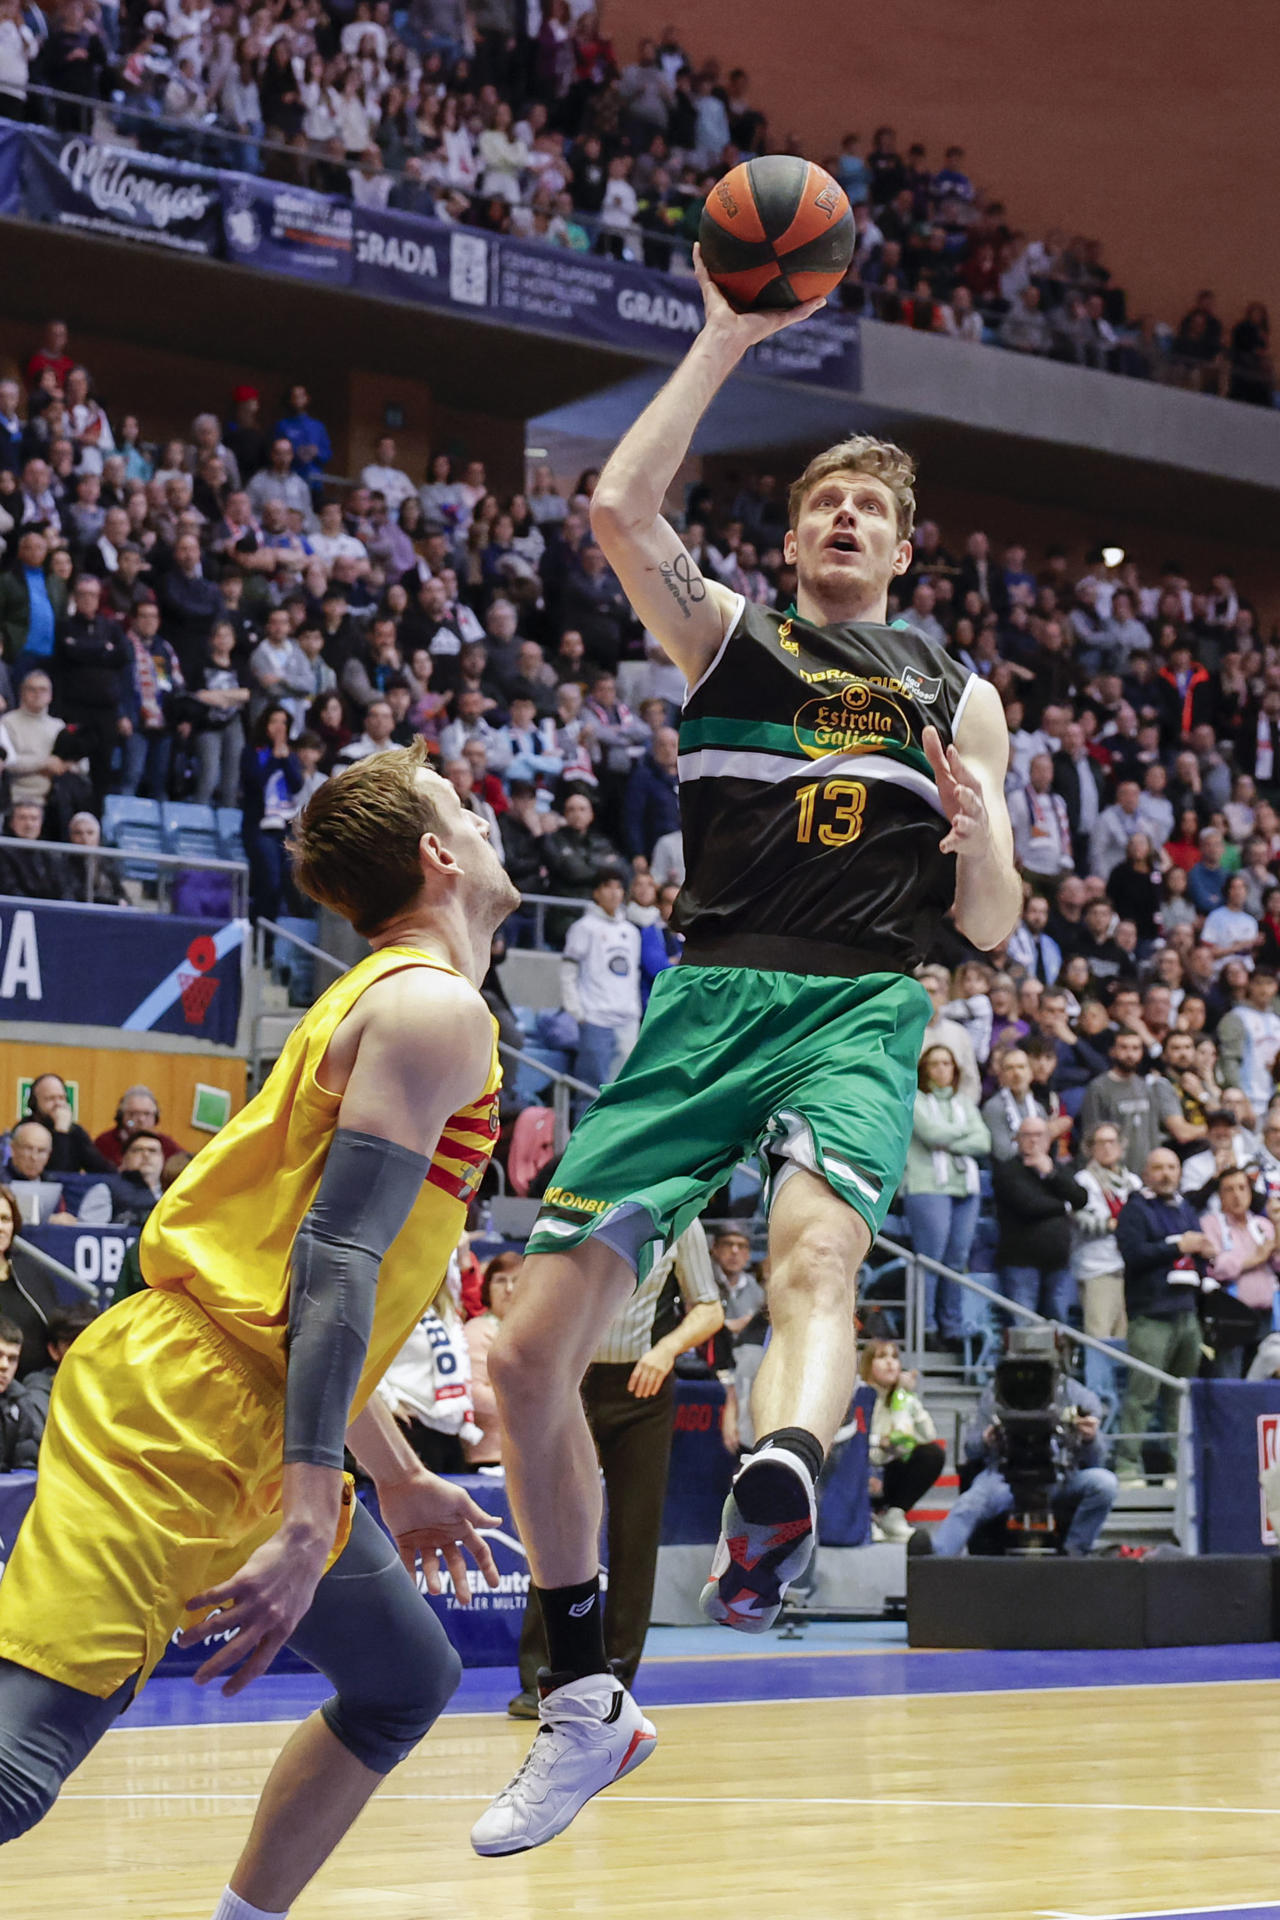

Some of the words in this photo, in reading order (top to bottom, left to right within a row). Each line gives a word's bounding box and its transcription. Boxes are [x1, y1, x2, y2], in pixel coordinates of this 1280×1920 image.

[617, 289, 700, 332] GRADA
[815, 706, 892, 732] Estrella
[796, 780, 867, 847] 13
[0, 910, 43, 1000] A
[74, 1235, 136, 1283] OB
